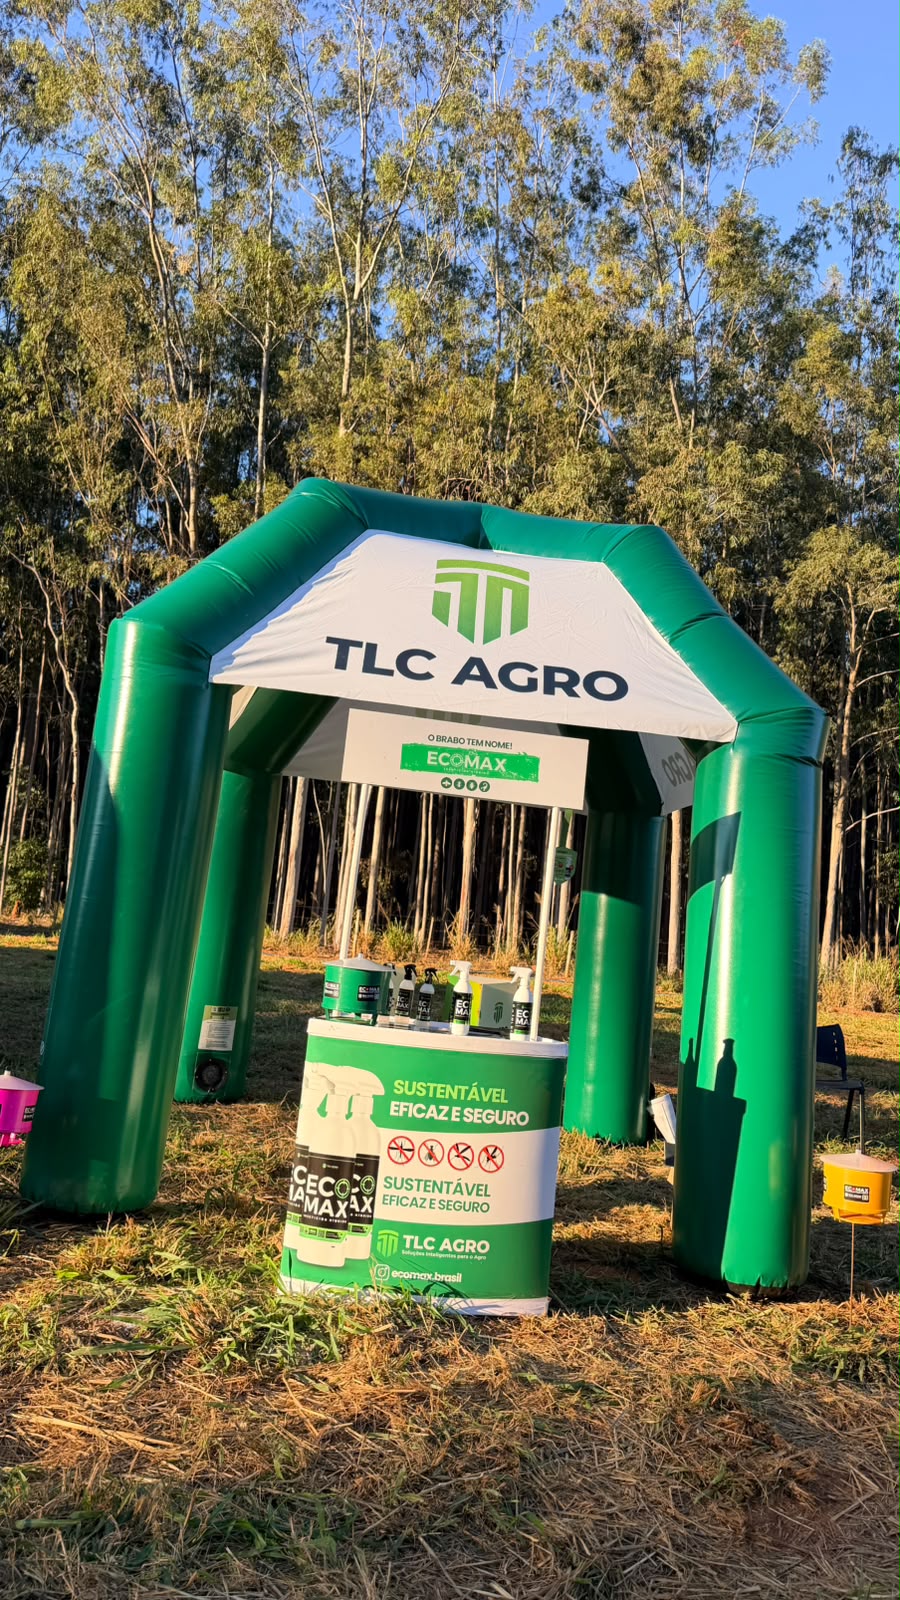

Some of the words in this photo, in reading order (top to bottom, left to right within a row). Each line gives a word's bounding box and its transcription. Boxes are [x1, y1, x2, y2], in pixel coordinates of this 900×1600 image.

[325, 636, 437, 681] TLC
[450, 656, 629, 702] AGRO
[427, 734, 435, 742] O
[436, 735, 466, 745] BRABO
[467, 738, 484, 747] TEM
[484, 740, 513, 750] NOME!
[427, 750, 508, 772] ECOMAX
[393, 1079, 508, 1104] SUSTENTÁVEL
[389, 1101, 449, 1121] EFICAZ
[451, 1106, 462, 1122] E
[463, 1107, 530, 1126] SEGURO
[306, 1173, 351, 1199] ECO
[383, 1175, 491, 1198] SUSTENTÁVEL
[303, 1195, 349, 1219] MAX
[349, 1195, 374, 1213] AX
[382, 1194, 427, 1209] EFICAZ
[429, 1198, 436, 1210] E
[438, 1199, 490, 1213] SEGURO
[402, 1234, 436, 1250] TLC
[439, 1238, 490, 1254] AGRO
[391, 1269, 462, 1283] ecomax.brasil
